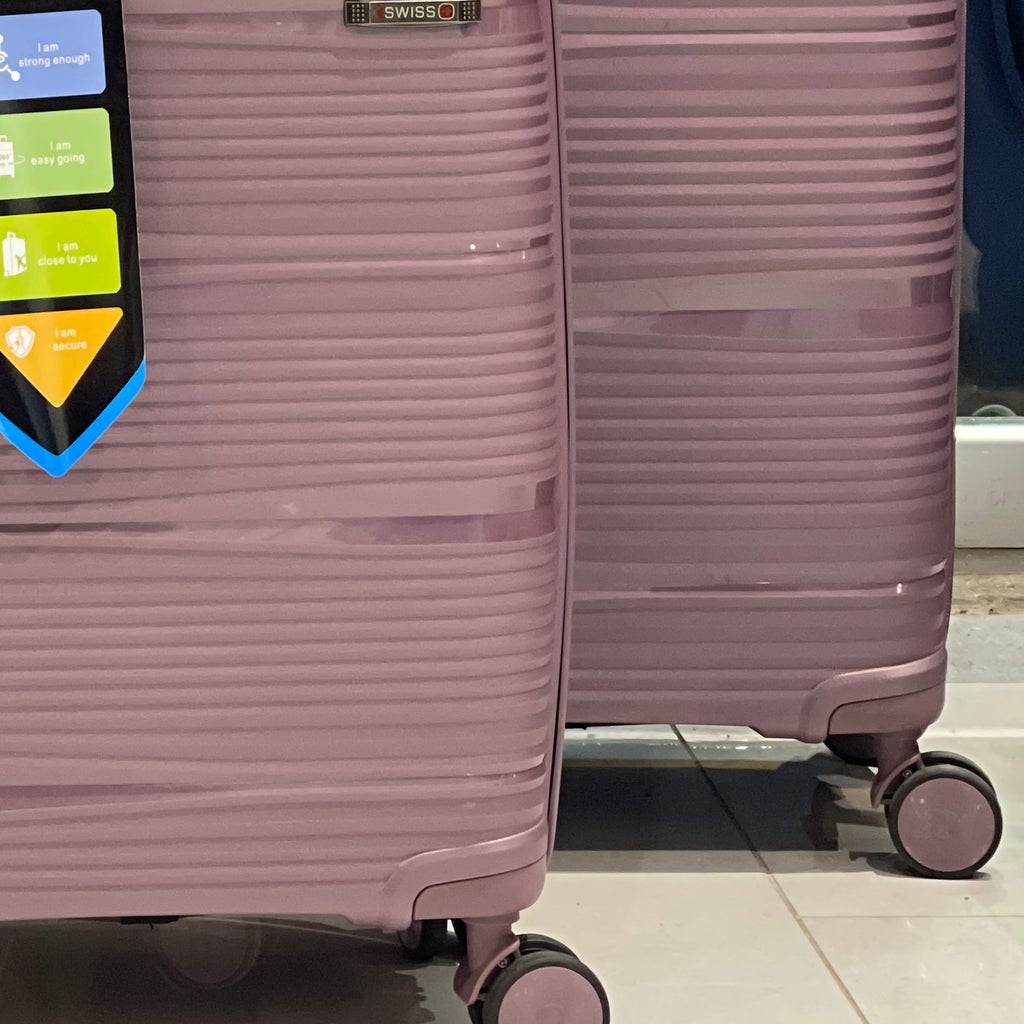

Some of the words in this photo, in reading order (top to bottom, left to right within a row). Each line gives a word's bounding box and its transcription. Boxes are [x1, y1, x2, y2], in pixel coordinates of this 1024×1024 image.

[42, 44, 59, 52] am
[18, 56, 50, 68] strong
[52, 53, 90, 65] enough
[56, 142, 71, 151] am
[30, 156, 55, 167] easy
[57, 154, 86, 166] going
[64, 242, 78, 251] am
[37, 253, 65, 266] close
[66, 254, 77, 265] to
[78, 254, 98, 267] you
[62, 329, 76, 338] am
[52, 340, 87, 352] secure
